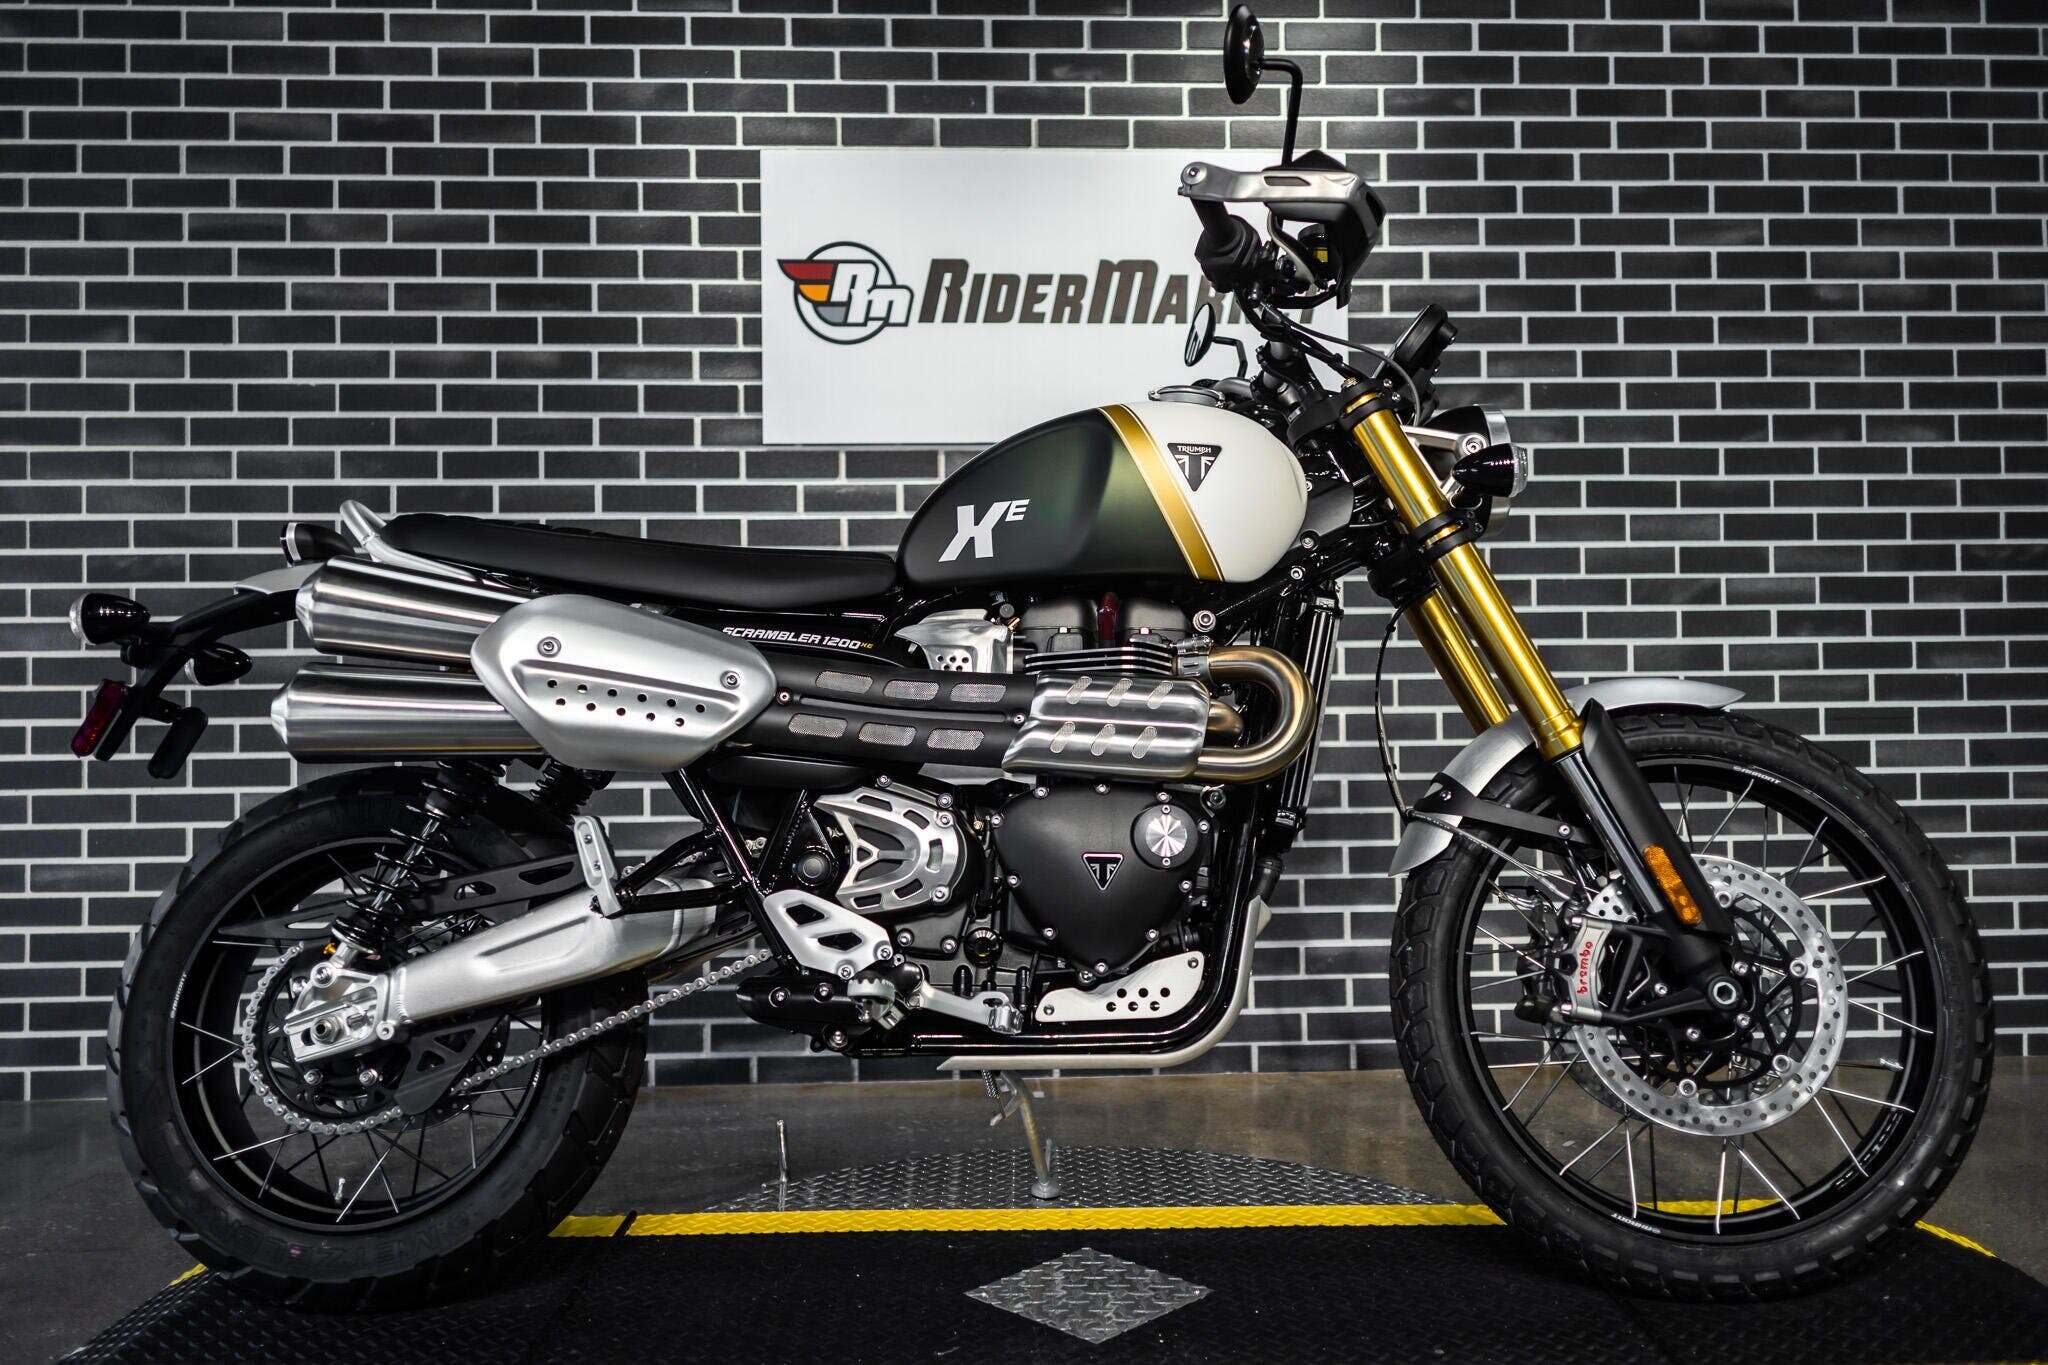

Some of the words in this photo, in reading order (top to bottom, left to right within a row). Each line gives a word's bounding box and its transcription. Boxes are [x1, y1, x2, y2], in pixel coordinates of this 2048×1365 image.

[1177, 445, 1212, 454] TRIUMPH
[722, 626, 822, 645] SCRAMBLER
[822, 635, 861, 650] 1200
[1577, 941, 1594, 994] brembo
